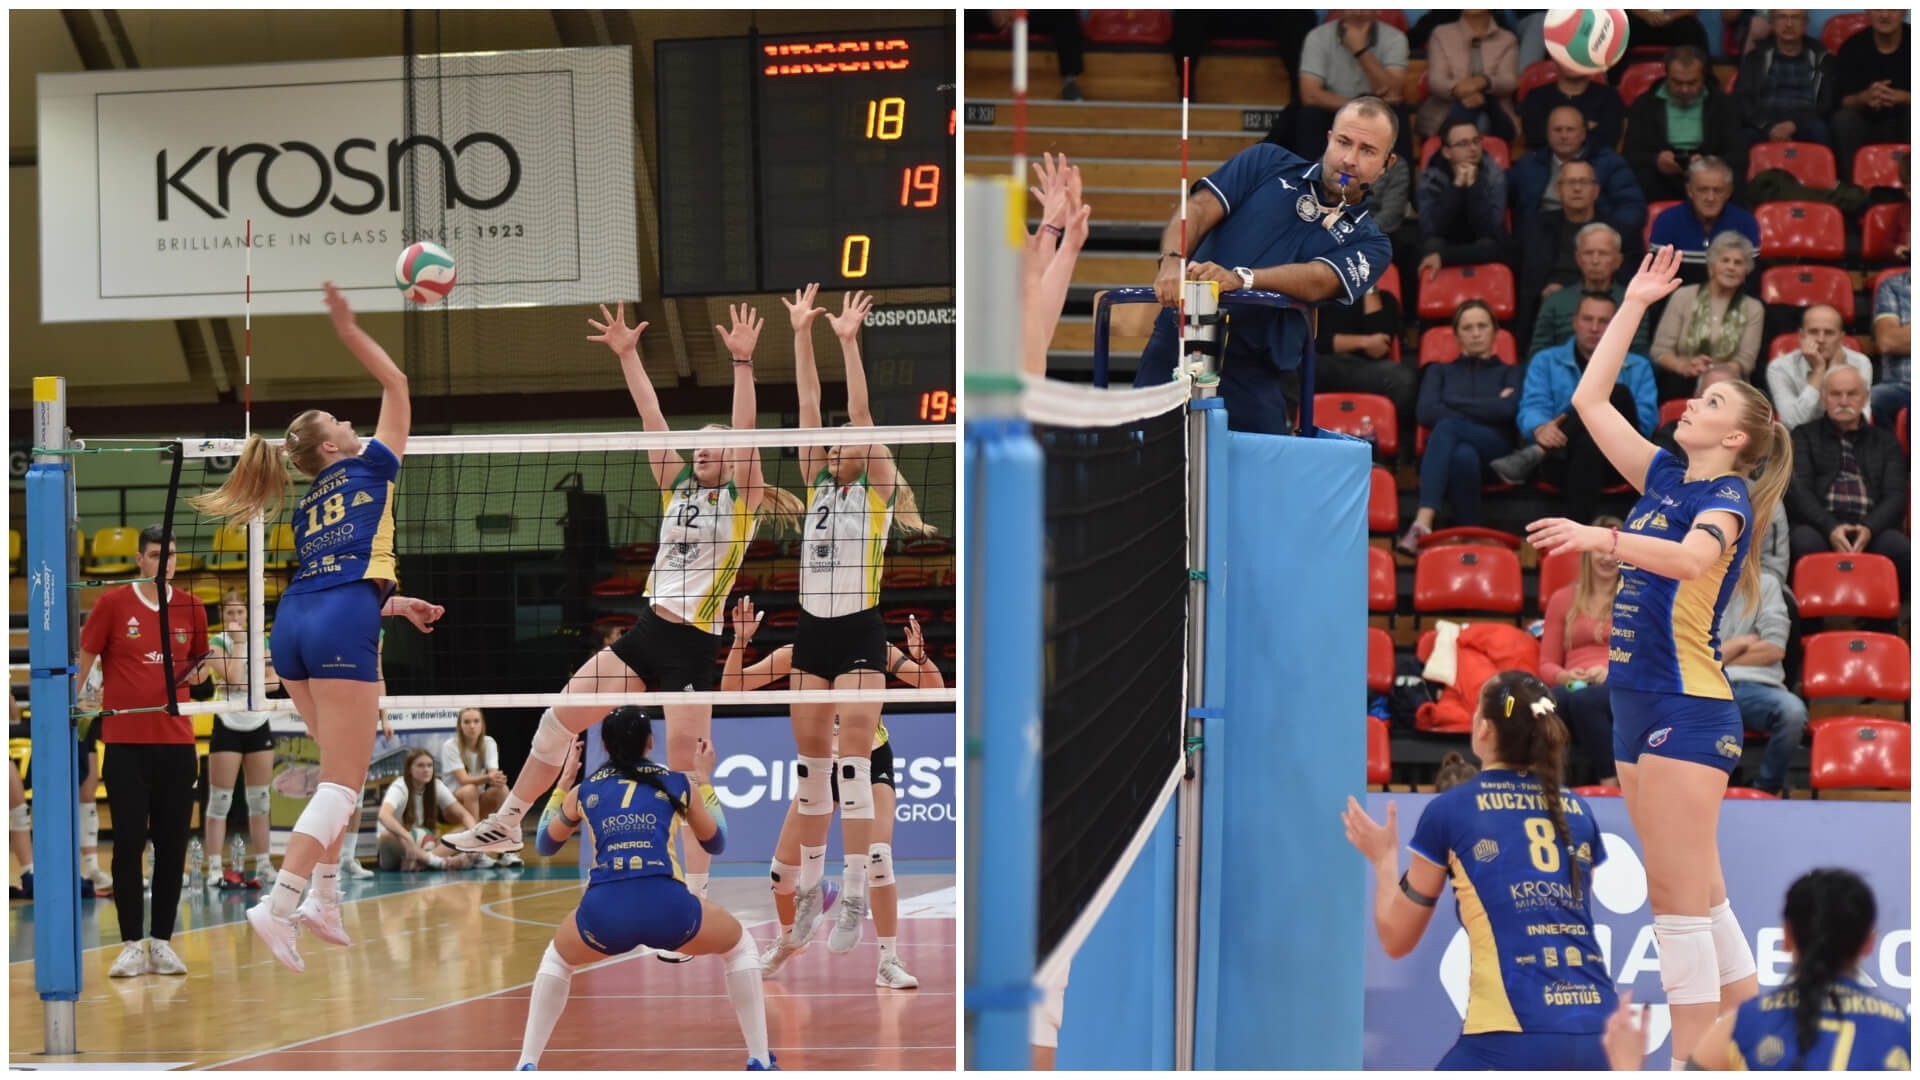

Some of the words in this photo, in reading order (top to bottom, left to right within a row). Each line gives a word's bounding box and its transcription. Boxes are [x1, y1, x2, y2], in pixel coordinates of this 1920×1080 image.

[866, 97, 905, 140] 18
[901, 164, 940, 207] 19
[157, 233, 277, 252] BRILLIANCE
[289, 232, 311, 246] IN
[324, 229, 388, 246] GLASS
[477, 224, 525, 239] 1923
[841, 234, 870, 277] 0
[304, 492, 346, 538] 18
[677, 504, 699, 528] 12
[816, 505, 830, 529] 2
[618, 779, 638, 808] 7
[1476, 792, 1584, 816] KUCZYŃKA
[602, 813, 657, 829] KROSNO
[1524, 817, 1560, 873] 8
[1544, 991, 1601, 1006] PORTIUS
